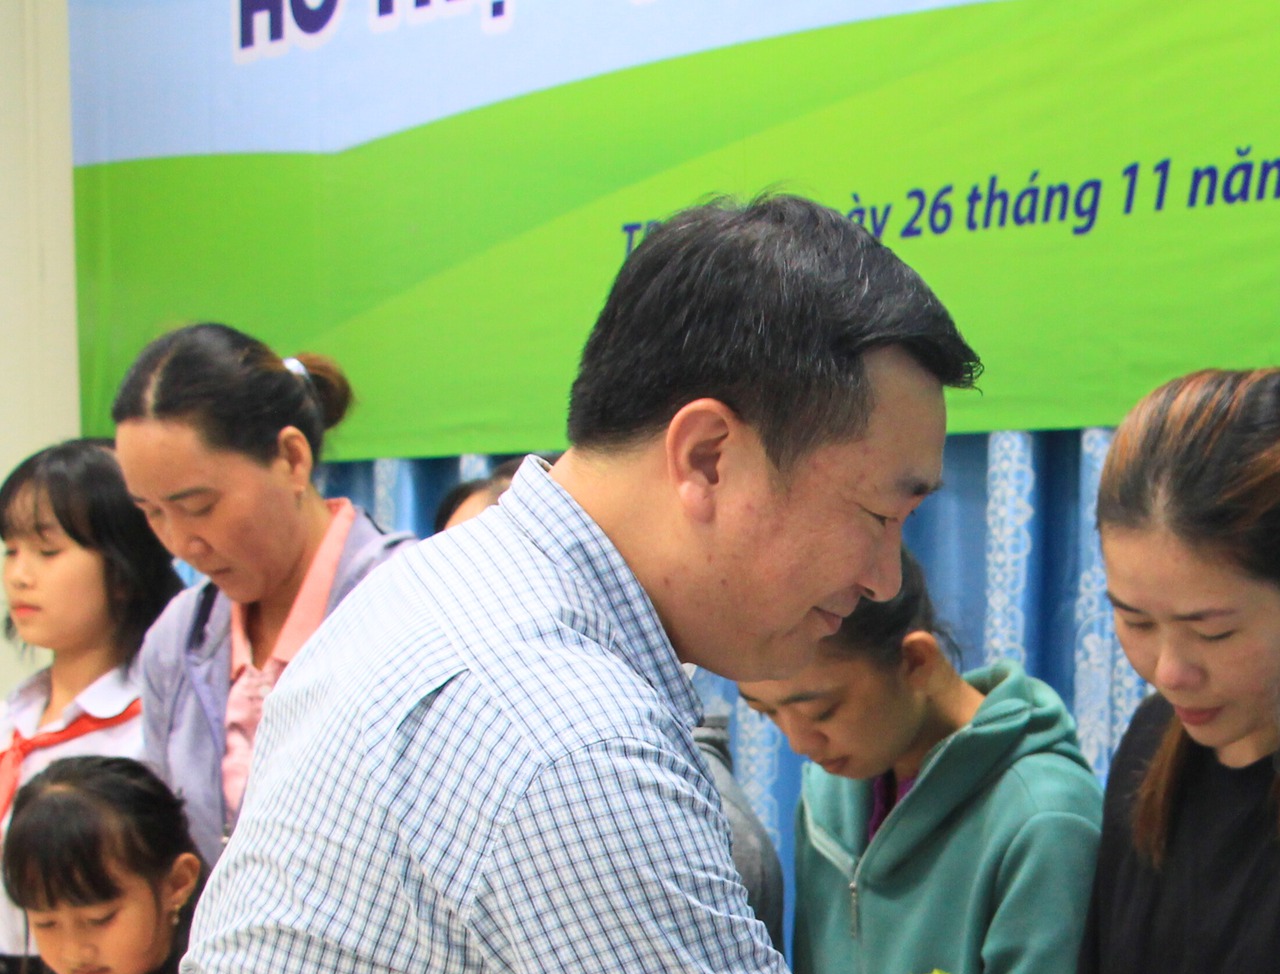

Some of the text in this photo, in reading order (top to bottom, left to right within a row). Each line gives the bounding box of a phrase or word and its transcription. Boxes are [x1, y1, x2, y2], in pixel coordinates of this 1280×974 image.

[900, 184, 954, 239] 26
[966, 169, 1103, 236] tháng
[1121, 158, 1172, 215] 11
